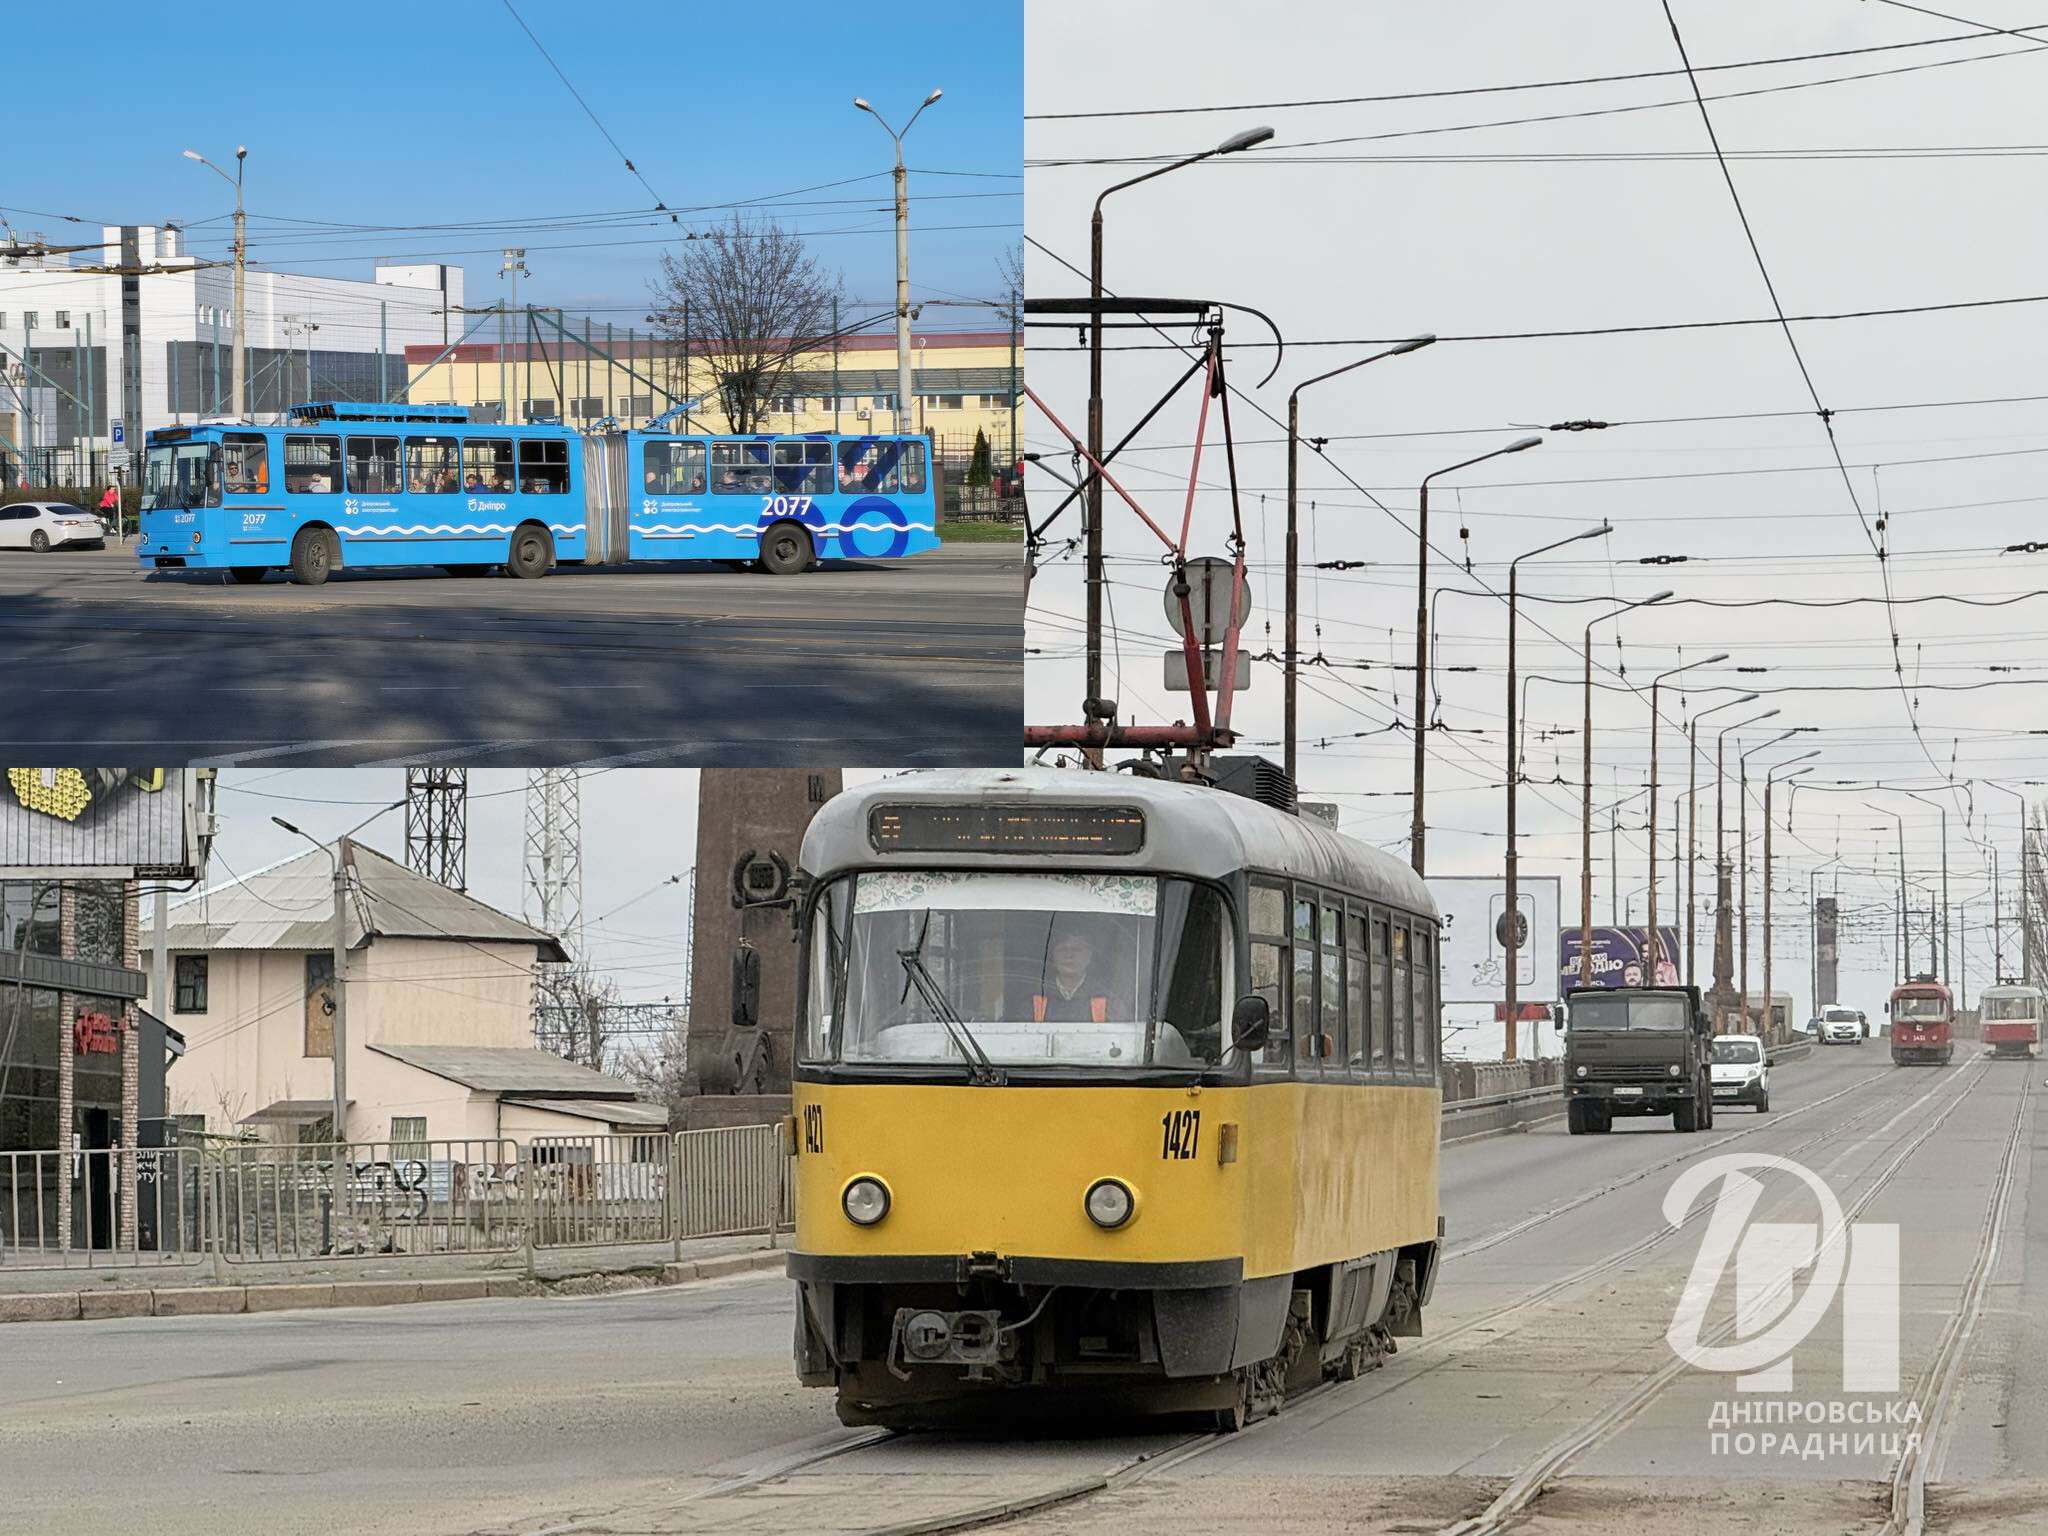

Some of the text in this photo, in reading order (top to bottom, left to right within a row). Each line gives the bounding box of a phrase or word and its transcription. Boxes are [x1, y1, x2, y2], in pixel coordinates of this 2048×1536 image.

[477, 500, 507, 511] Дніпро
[761, 496, 813, 516] 2077
[180, 513, 196, 523] 2077
[242, 513, 266, 525] 2077
[804, 1104, 823, 1153] 1427
[1162, 1110, 1200, 1159] 1427
